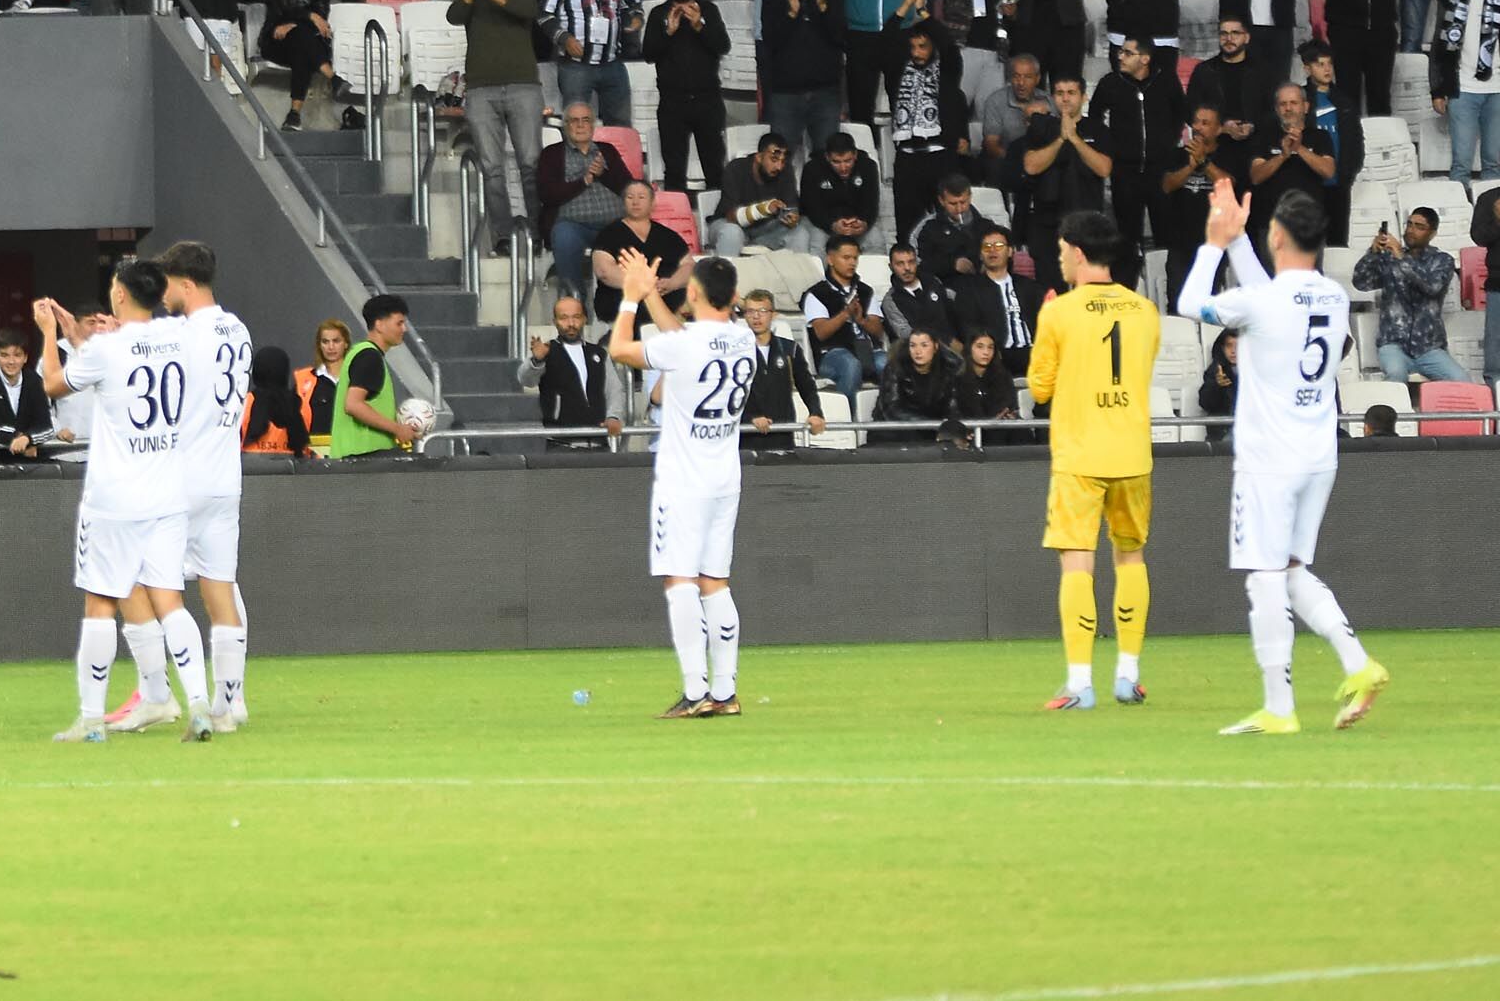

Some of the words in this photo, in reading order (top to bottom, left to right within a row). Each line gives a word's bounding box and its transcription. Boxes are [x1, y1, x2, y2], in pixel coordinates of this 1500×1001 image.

[214, 341, 253, 407] 33
[1102, 320, 1121, 386] 1
[1299, 315, 1329, 383] 5
[127, 361, 186, 431] 30
[693, 357, 755, 419] 28
